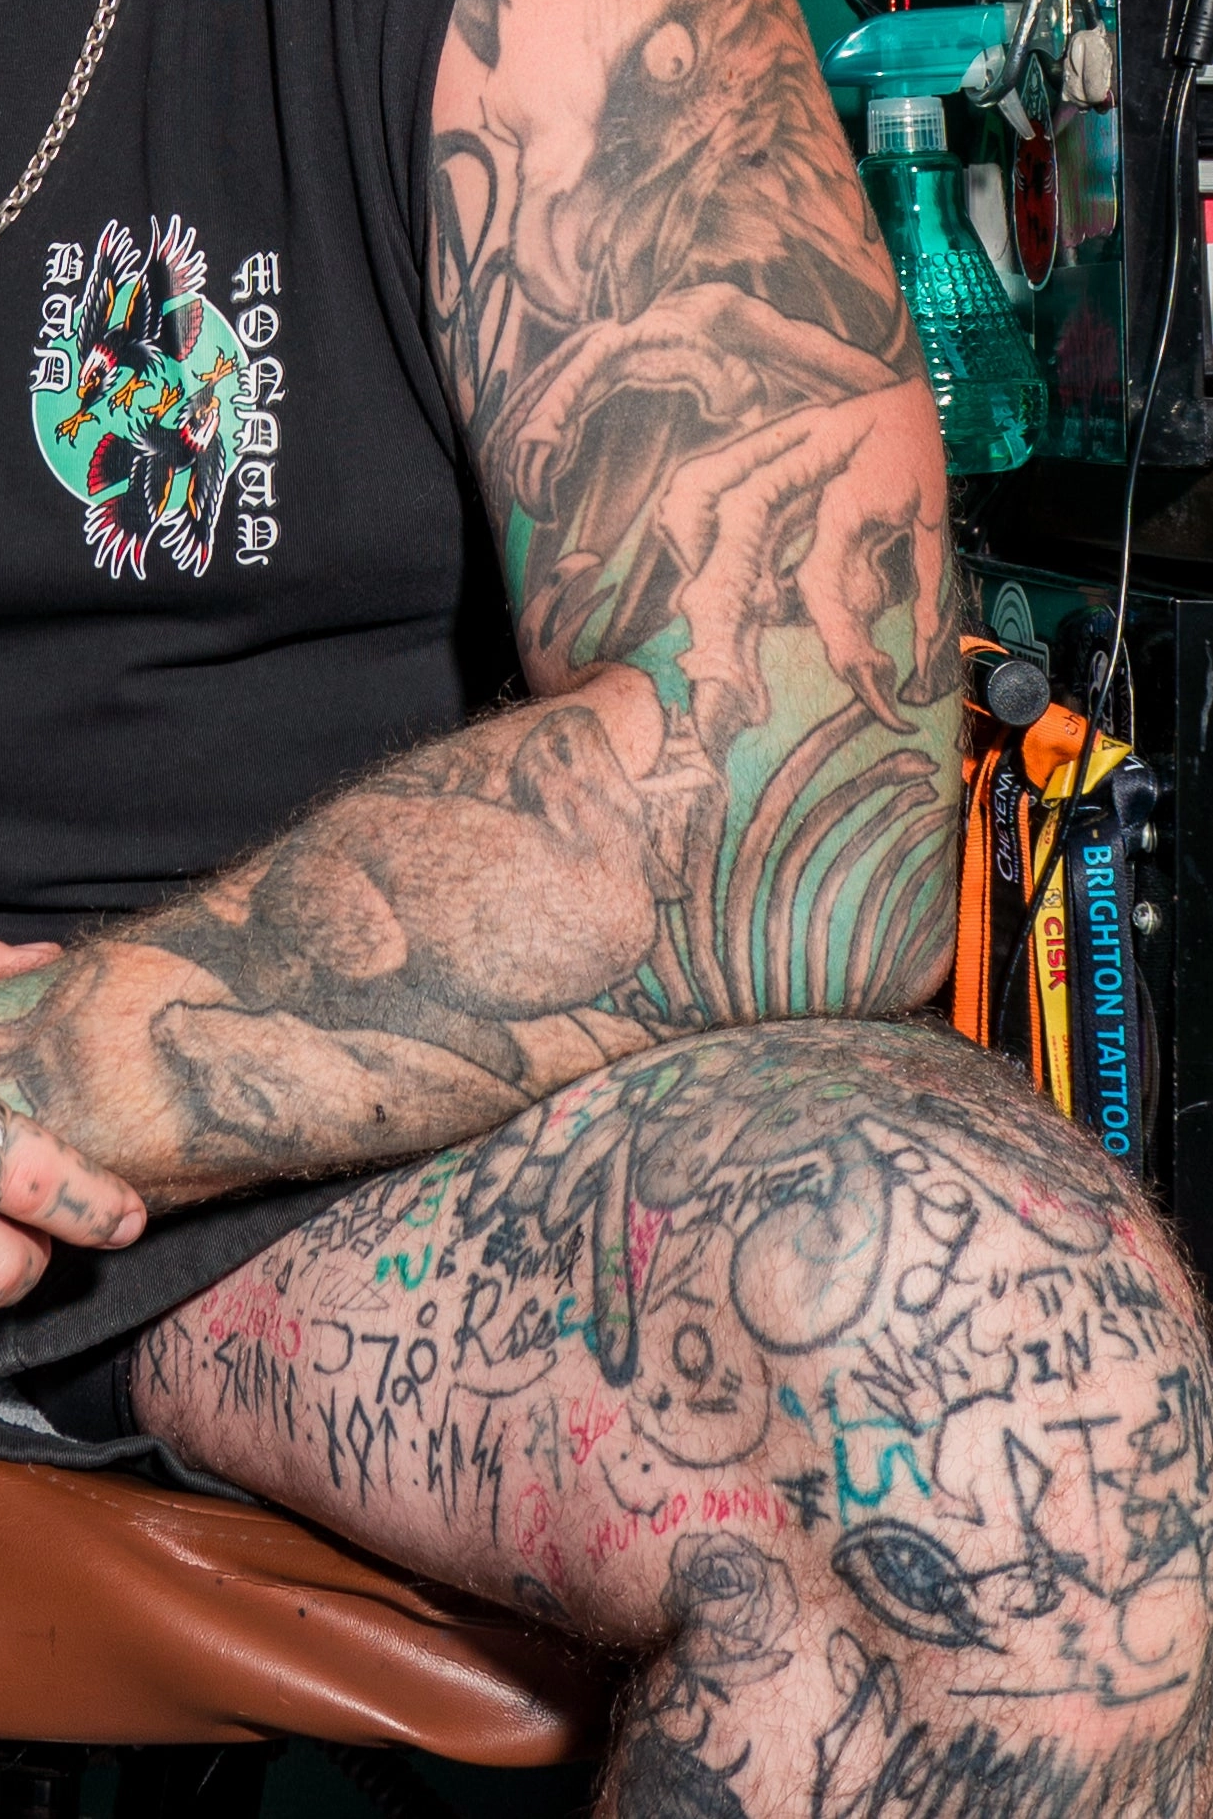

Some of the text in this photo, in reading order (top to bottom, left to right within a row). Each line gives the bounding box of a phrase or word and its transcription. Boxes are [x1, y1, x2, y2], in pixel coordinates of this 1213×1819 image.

[29, 241, 85, 394] BAD
[231, 251, 288, 566] MONDAY
[994, 769, 1015, 881] CHEYENN
[1044, 916, 1068, 990] CISK
[1083, 844, 1130, 1157] BRIGHTON TATTOO
